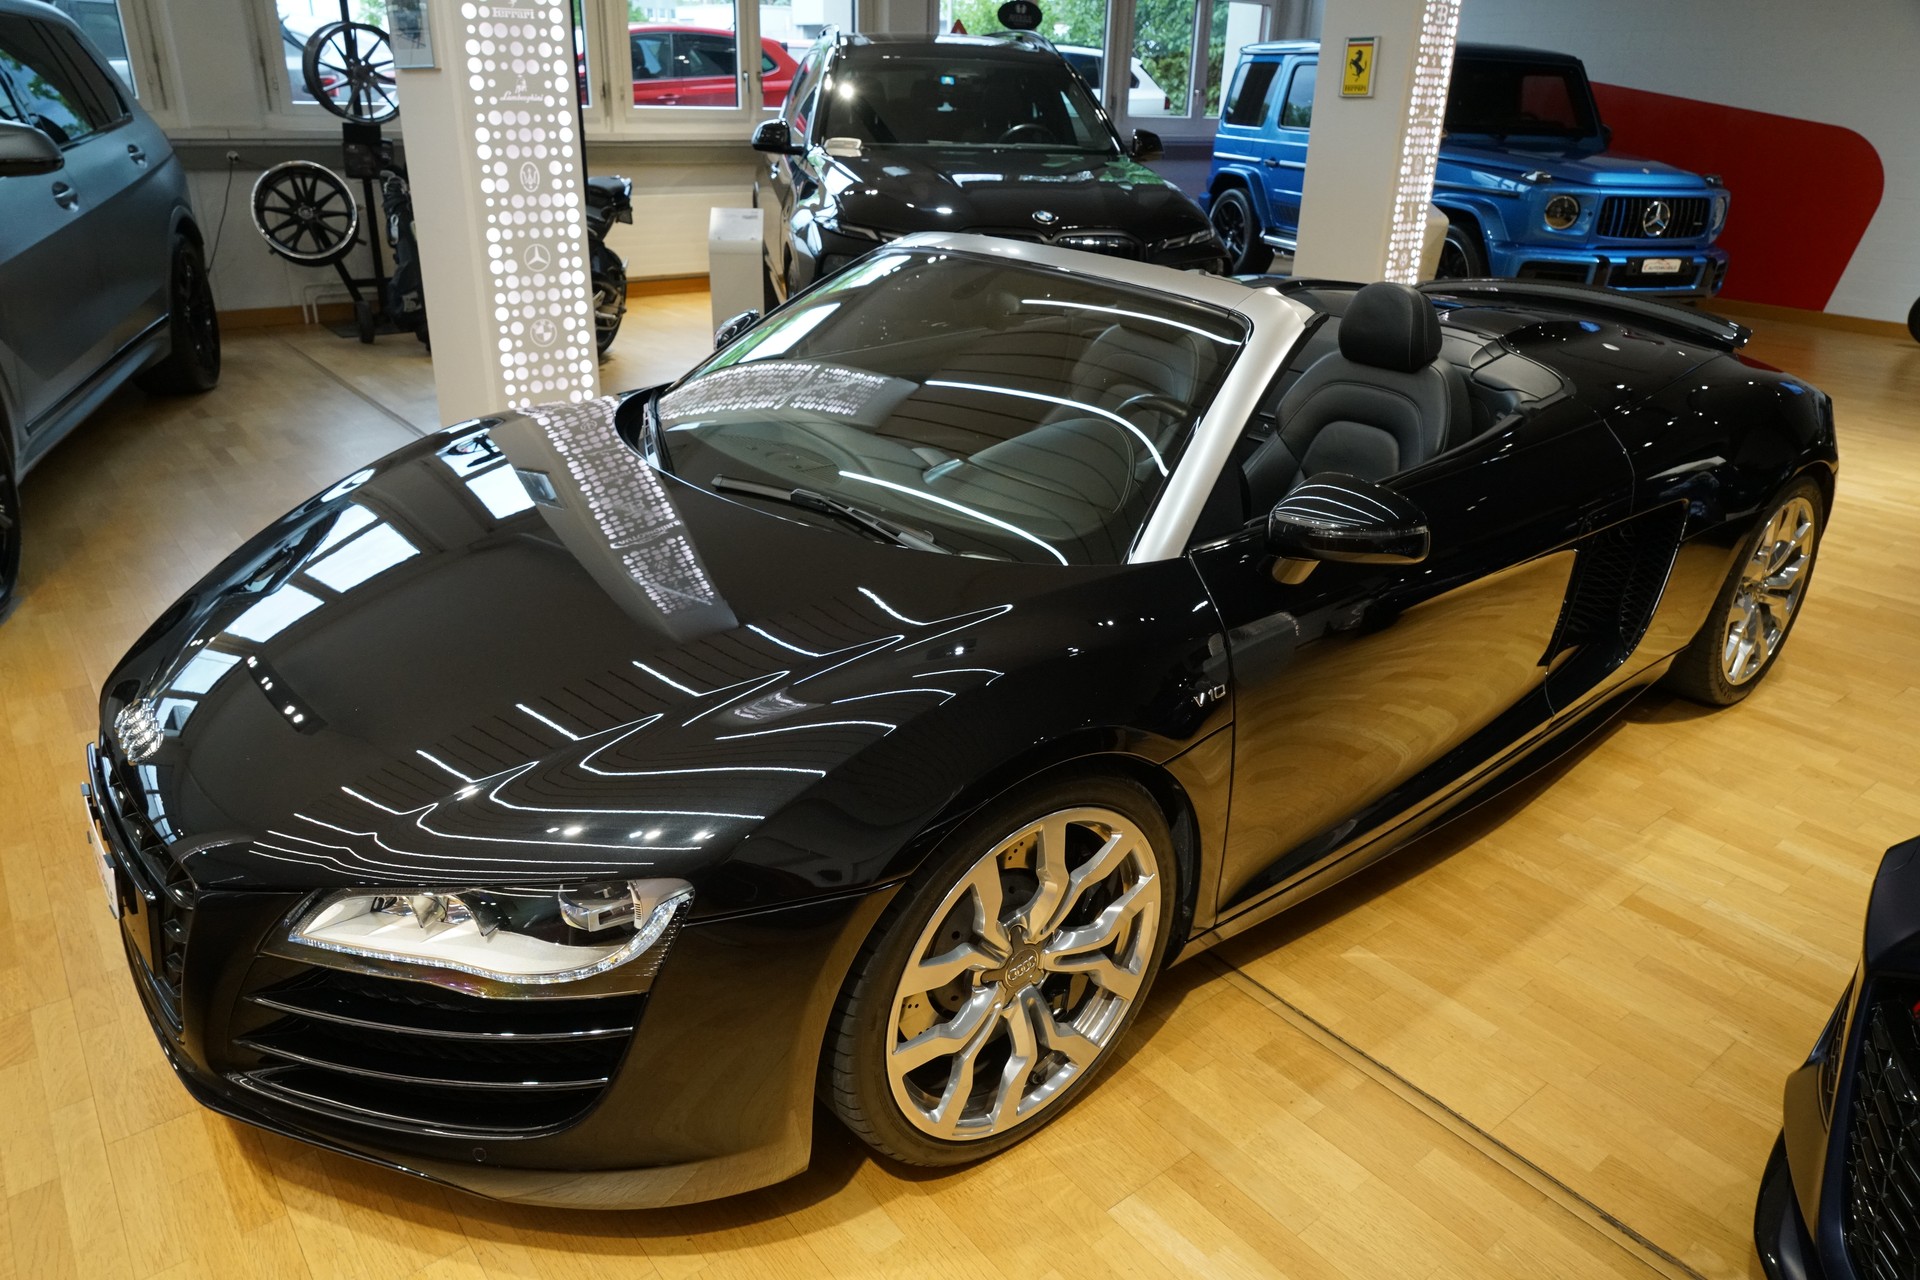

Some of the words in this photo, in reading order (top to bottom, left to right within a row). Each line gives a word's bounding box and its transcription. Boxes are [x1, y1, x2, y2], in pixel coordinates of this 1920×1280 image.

[492, 7, 535, 19] Ferrari
[499, 90, 544, 103] Lamborghini
[1193, 684, 1226, 707] V10
